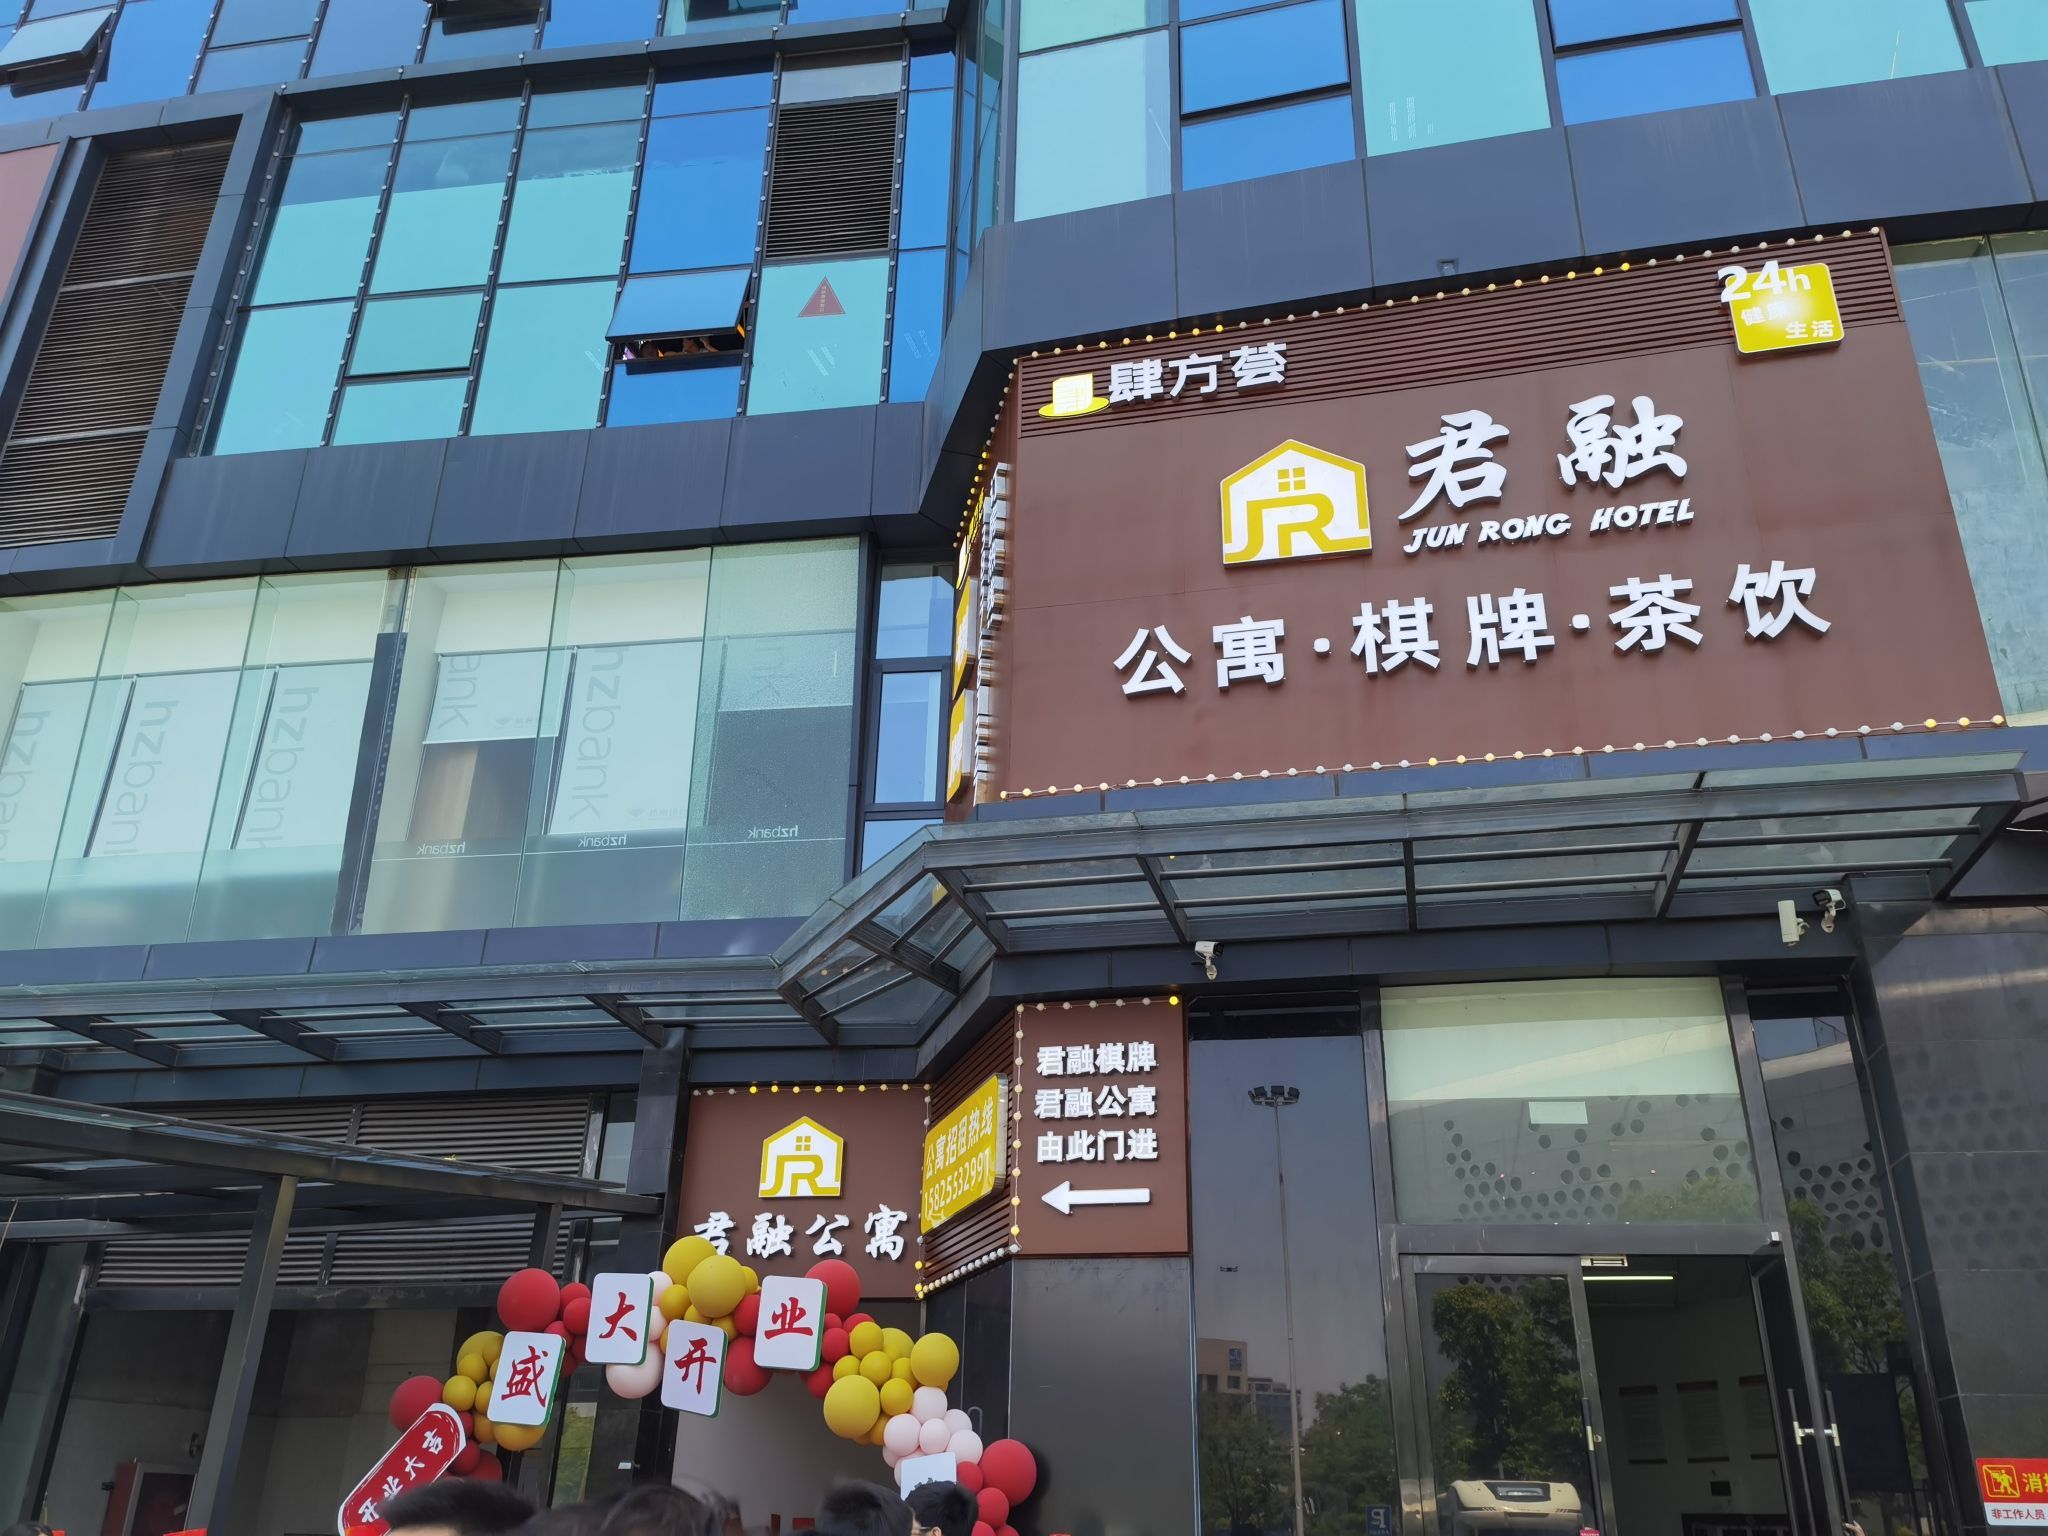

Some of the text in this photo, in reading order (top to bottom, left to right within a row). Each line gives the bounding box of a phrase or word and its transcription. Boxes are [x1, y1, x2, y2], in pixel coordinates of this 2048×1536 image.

[1717, 260, 1811, 303] 24h
[1785, 319, 1835, 339] 生活
[1109, 342, 1288, 403] 肆方荟
[1398, 395, 1688, 521] 君融
[1403, 497, 1696, 556] JUN RONG HOTEL
[1036, 1041, 1157, 1076] 君融棋牌
[1034, 1084, 1157, 1119] 君融公寓
[925, 1096, 994, 1180] 公寓招租热线
[1036, 1128, 1159, 1163] 由此门进
[694, 1203, 908, 1260] 君融公寓
[501, 1291, 813, 1407] 盛 大 开 业
[1991, 1508, 2046, 1521] 非工作人员
